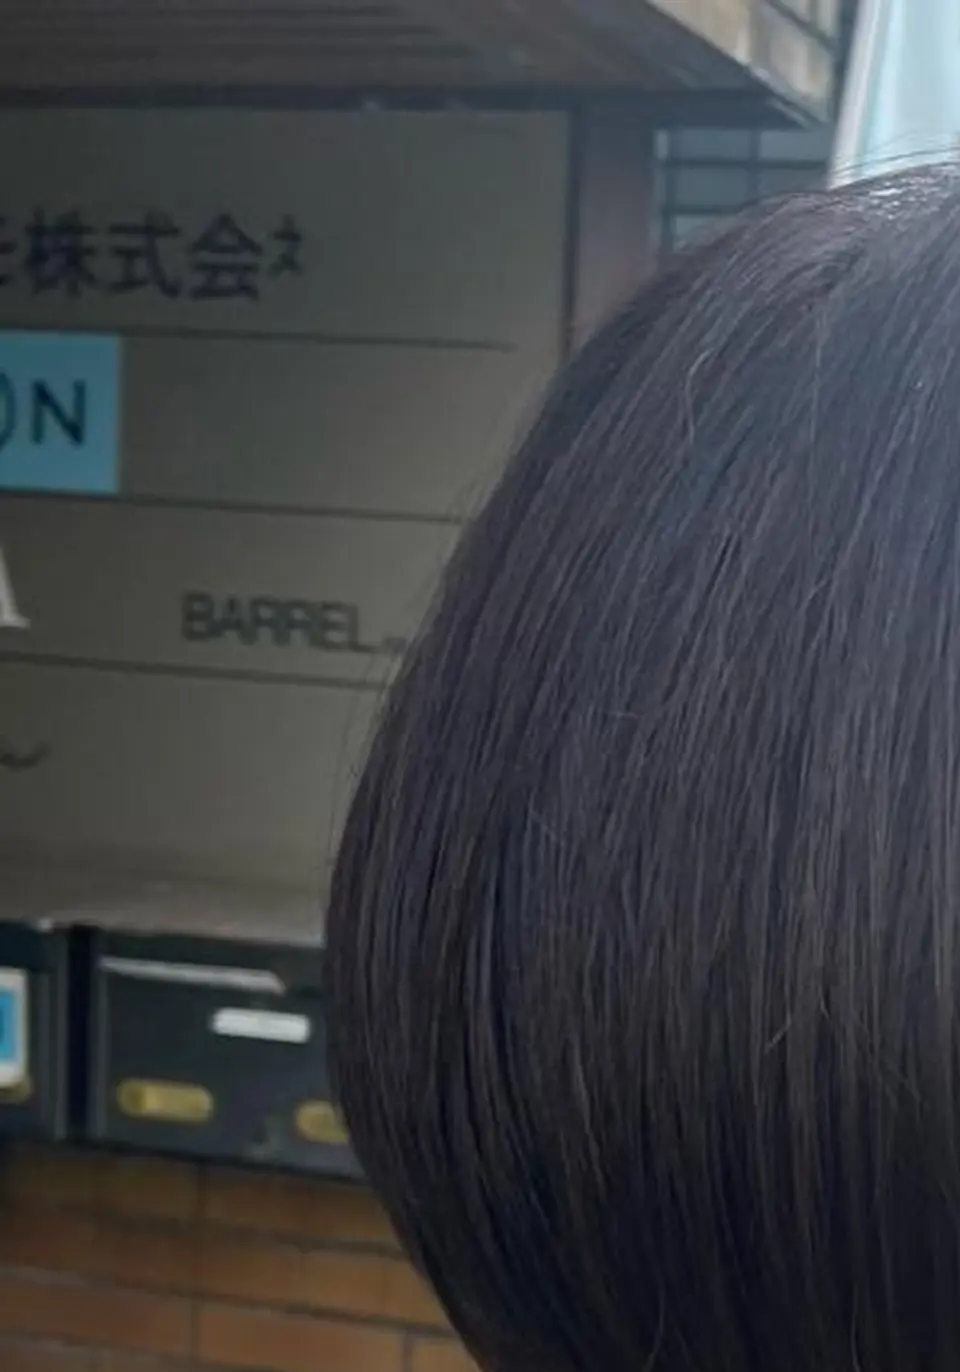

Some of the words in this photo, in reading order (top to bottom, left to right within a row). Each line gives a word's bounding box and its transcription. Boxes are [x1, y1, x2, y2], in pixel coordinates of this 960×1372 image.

[0, 205, 303, 300] 株式会
[0, 371, 87, 450] N
[182, 593, 376, 653] BARREL
